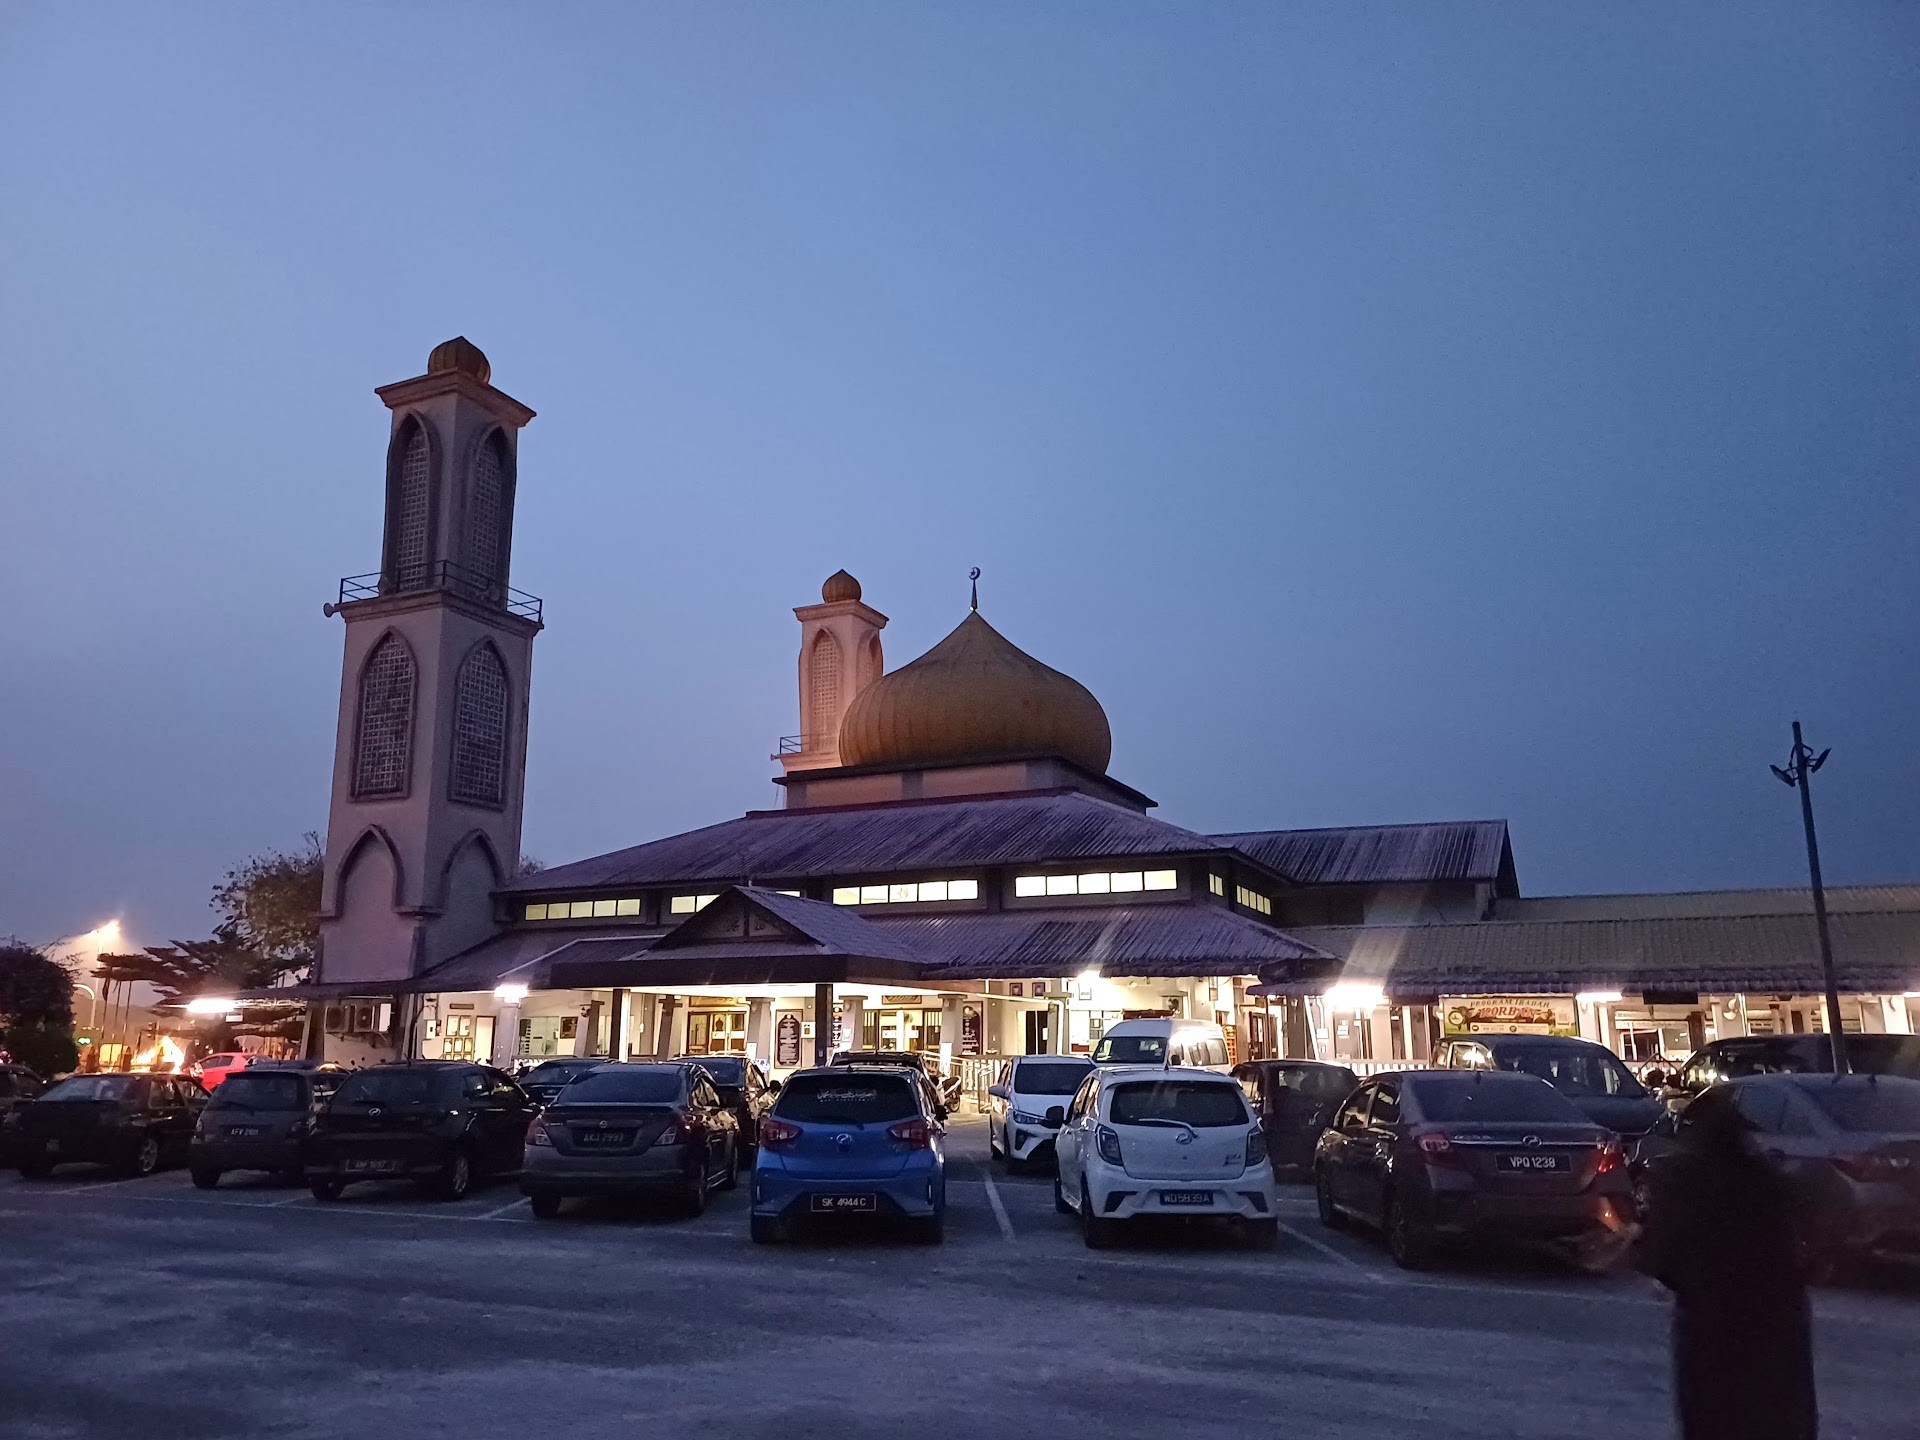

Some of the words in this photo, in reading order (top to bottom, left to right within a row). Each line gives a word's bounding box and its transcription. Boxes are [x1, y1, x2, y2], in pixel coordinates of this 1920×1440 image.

[1470, 998, 1513, 1007] PROGRAM
[1509, 1156, 1530, 1168] VPQ
[1531, 1156, 1556, 1168] 1238
[821, 1197, 834, 1207] SK
